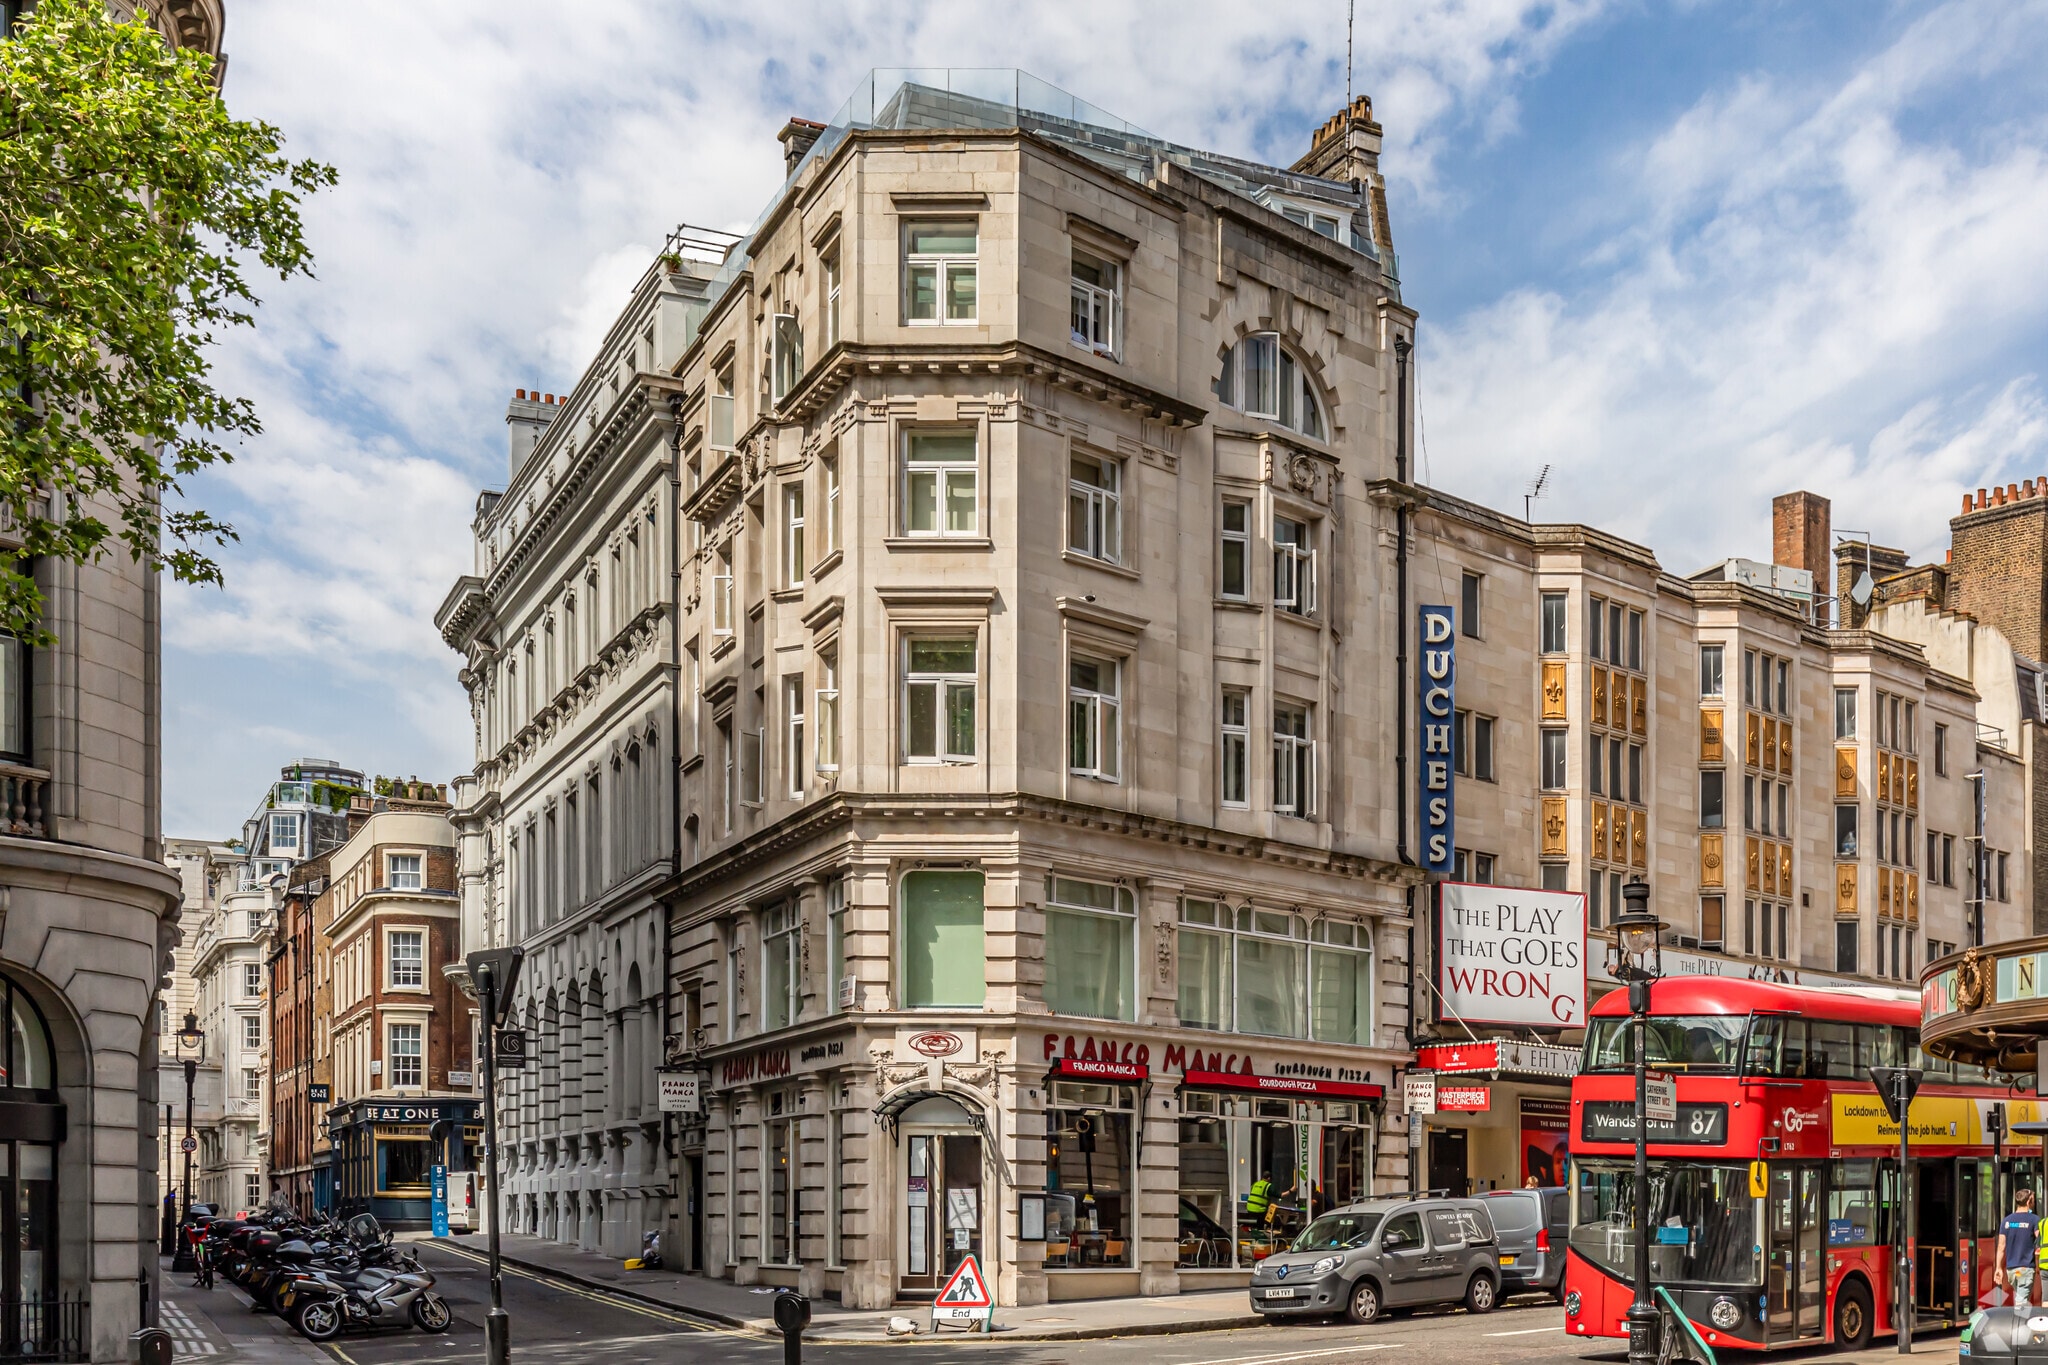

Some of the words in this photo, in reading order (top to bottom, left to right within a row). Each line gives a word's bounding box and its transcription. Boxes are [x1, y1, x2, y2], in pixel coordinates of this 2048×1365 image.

[1425, 614, 1451, 863] DUCHESS
[1453, 908, 1490, 927] THE
[1496, 904, 1563, 935] PLAY
[1447, 938, 1497, 958] THAT
[1501, 937, 1578, 968] GOES
[1680, 960, 1695, 973] THE
[1044, 1034, 1149, 1065] FRANCO
[1163, 1043, 1254, 1075] MANCA
[723, 1055, 754, 1085] FRANCO
[757, 1049, 791, 1080] MANCA
[1073, 1062, 1105, 1073] FRANCO
[1107, 1064, 1136, 1075] MANCA
[1275, 1062, 1331, 1079] SOURDOUGH
[1338, 1067, 1370, 1082] PIZZA
[1259, 1078, 1296, 1089] SOURDOUGH
[1297, 1082, 1317, 1091] PIZZA
[1647, 1084, 1667, 1095] CATHERINE
[1647, 1095, 1661, 1104] STREET
[1661, 1097, 1670, 1106] WC2
[367, 1108, 379, 1119] BE
[383, 1108, 399, 1119] AT
[405, 1108, 439, 1119] ONE
[1844, 1105, 1879, 1116] Lockdown
[1595, 1113, 1673, 1129] Wandsorth
[1691, 1110, 1718, 1135] 87
[1878, 1124, 1901, 1135] Reinve
[1920, 1125, 1930, 1137] job
[1931, 1125, 1947, 1136] hunt.
[952, 1309, 970, 1318] End
[156, 1342, 160, 1351] 1
